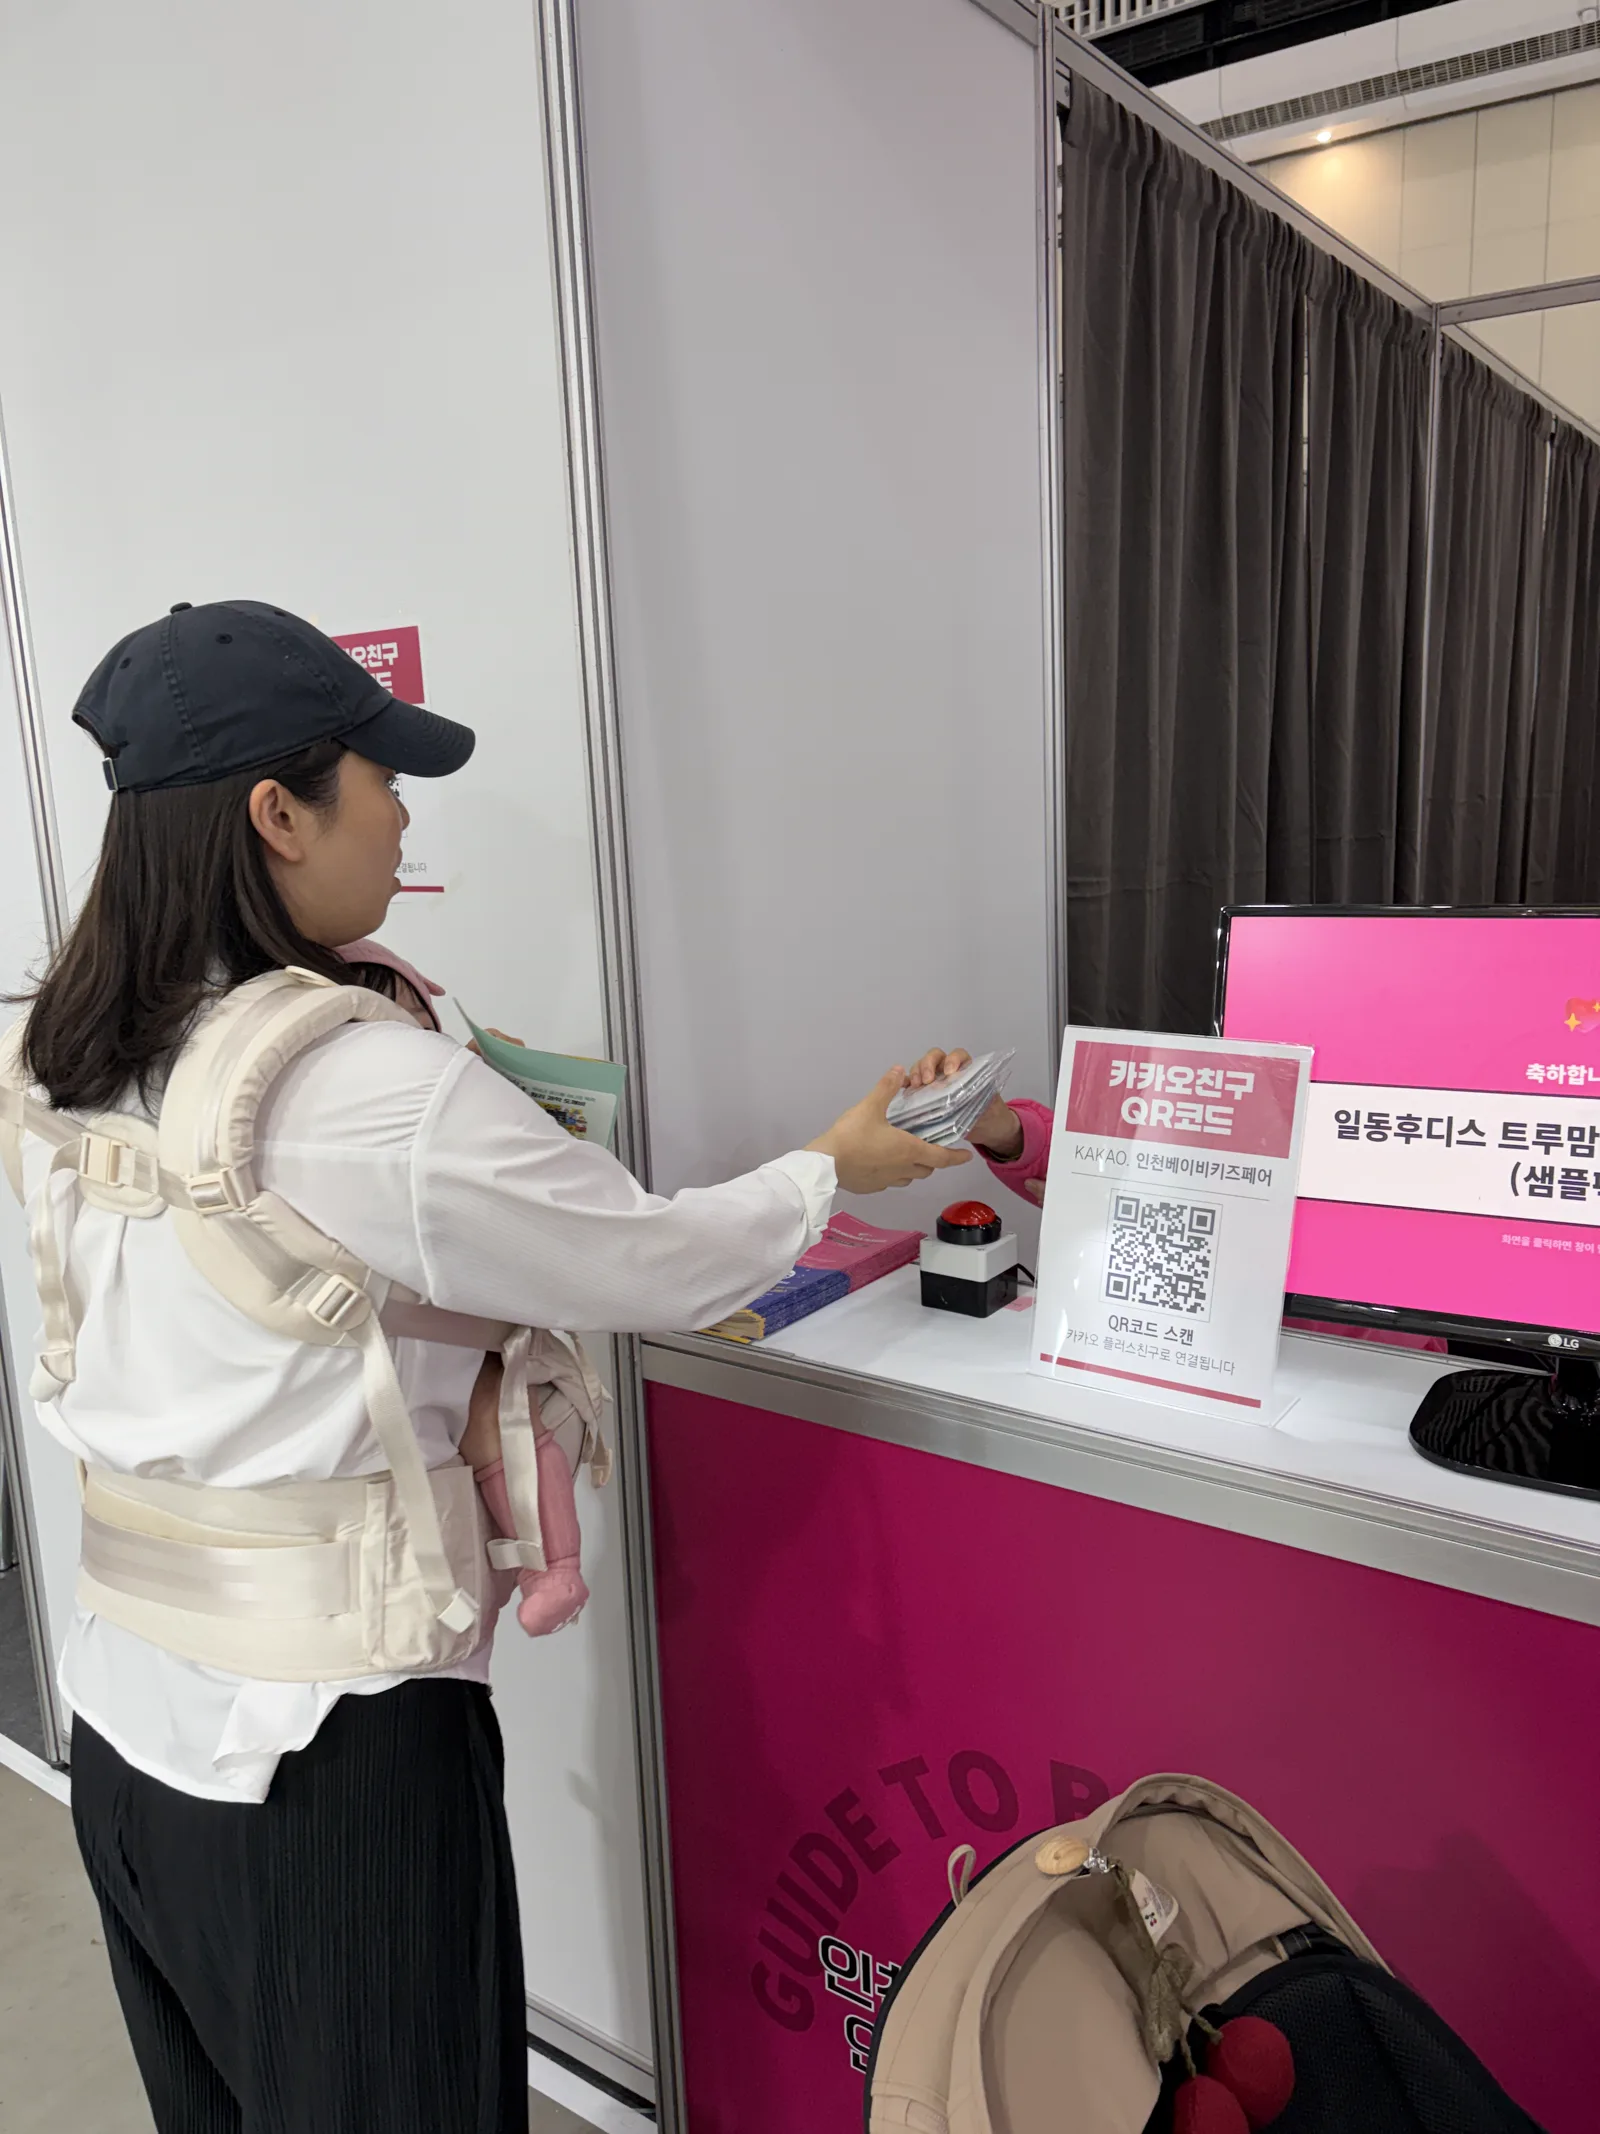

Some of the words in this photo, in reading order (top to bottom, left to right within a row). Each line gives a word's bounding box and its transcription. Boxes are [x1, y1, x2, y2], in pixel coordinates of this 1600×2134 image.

[342, 642, 399, 669] 오친구
[1109, 1060, 1255, 1100] 카카오친구
[1120, 1096, 1235, 1136] QR코드
[1334, 1109, 1487, 1148] 일동후디스
[1498, 1121, 1600, 1159] 트루맘
[1075, 1145, 1130, 1167] KAKAO.
[1136, 1152, 1272, 1187] 인천베이비키즈페어
[1510, 1161, 1600, 1202] (샘플
[1501, 1233, 1531, 1247] 화면을
[1575, 1241, 1595, 1254] 창이
[1108, 1314, 1158, 1338] QR코드
[1163, 1325, 1195, 1347] 스캔
[1066, 1328, 1099, 1347] 카카오
[1102, 1335, 1171, 1362] 플러스친구로
[1175, 1350, 1236, 1376] 연결됩니다
[751, 1786, 902, 2033] GUIDE
[877, 1750, 1020, 1840] TO
